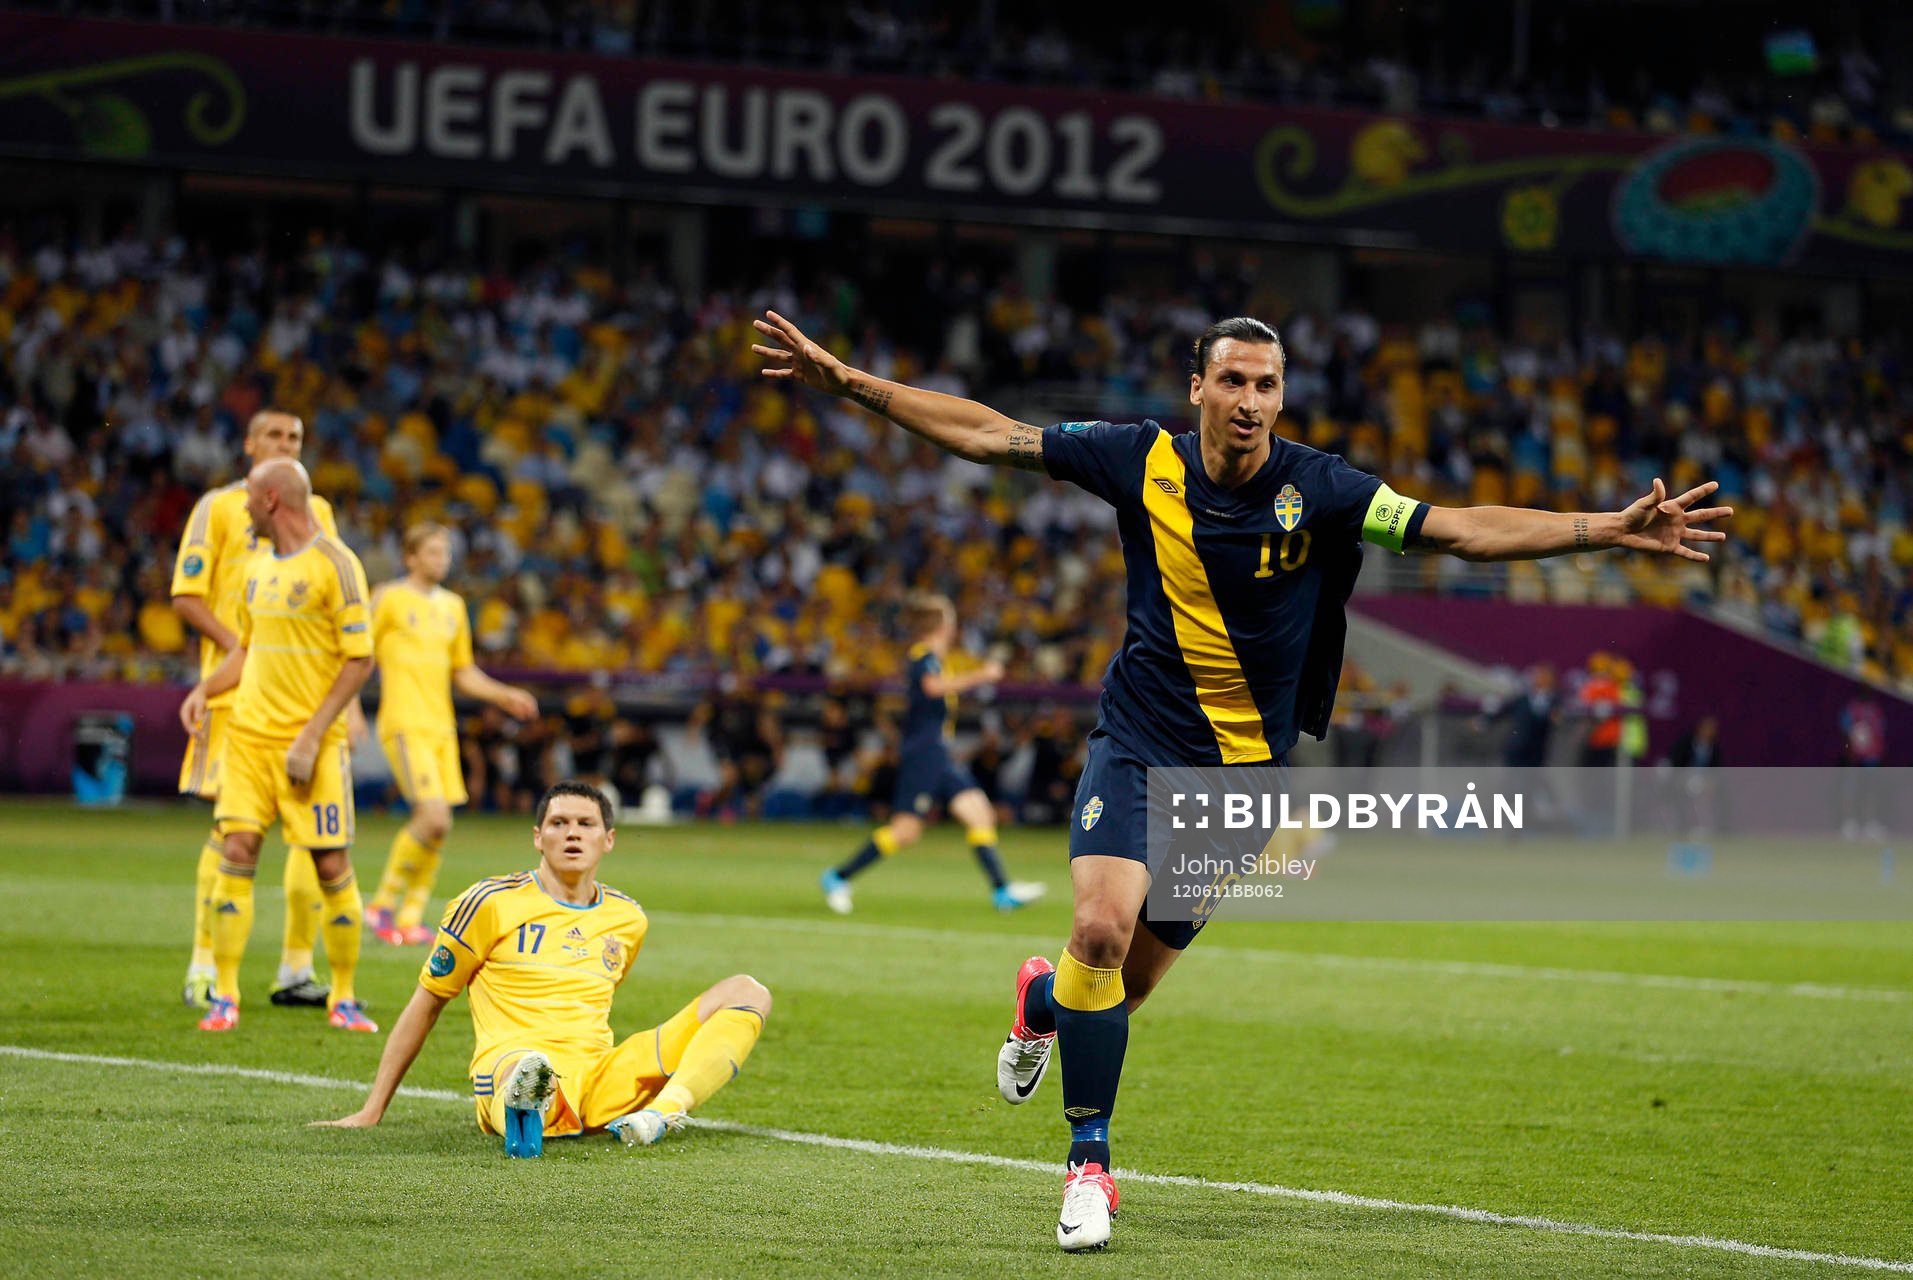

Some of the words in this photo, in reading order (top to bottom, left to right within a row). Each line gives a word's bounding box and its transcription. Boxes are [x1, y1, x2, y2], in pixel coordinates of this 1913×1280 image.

[350, 58, 613, 166] UEFA
[635, 80, 908, 186] EURO
[925, 101, 1164, 202] 2012
[1388, 501, 1407, 537] RESPECT
[1253, 528, 1313, 579] 10
[312, 803, 340, 837] 18
[516, 922, 547, 954] 17
